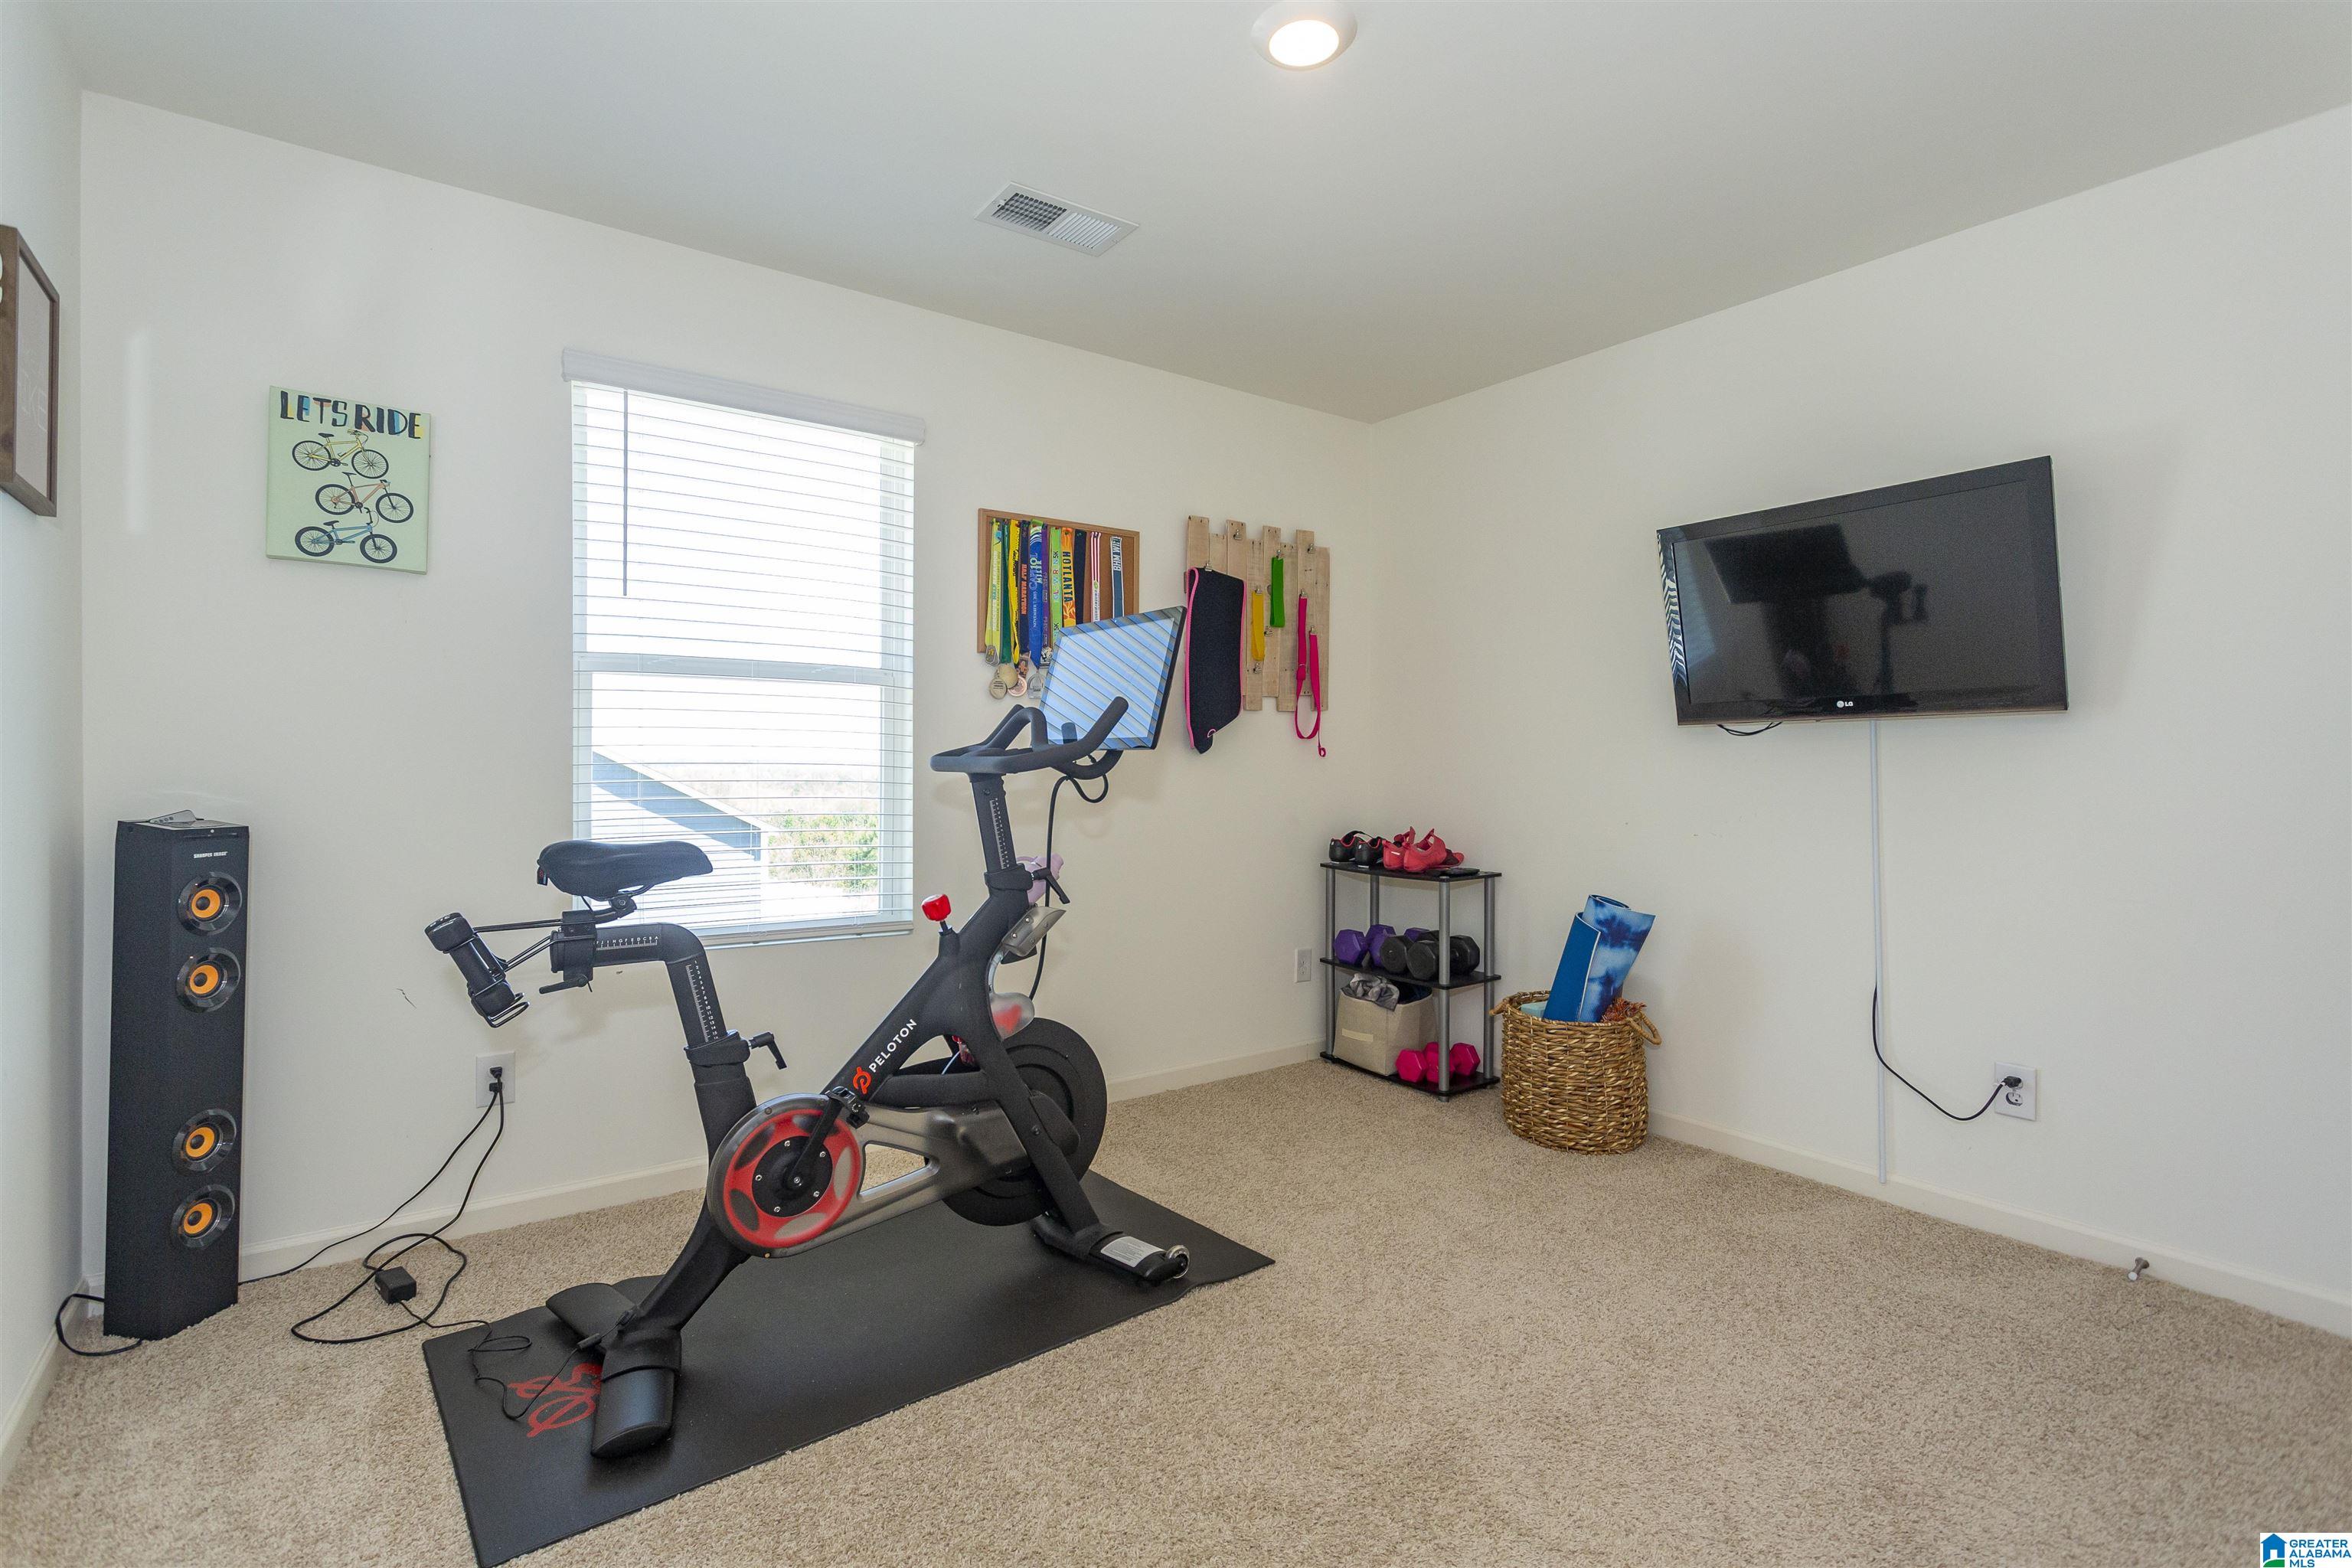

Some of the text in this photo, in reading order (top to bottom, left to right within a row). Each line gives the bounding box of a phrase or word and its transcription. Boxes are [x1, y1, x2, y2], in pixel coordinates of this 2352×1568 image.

[280, 390, 423, 439] LETS RIDE
[1063, 551, 1073, 603] HOTLANTA
[1113, 555, 1122, 571] BHM
[868, 1018, 917, 1073] PELOTON
